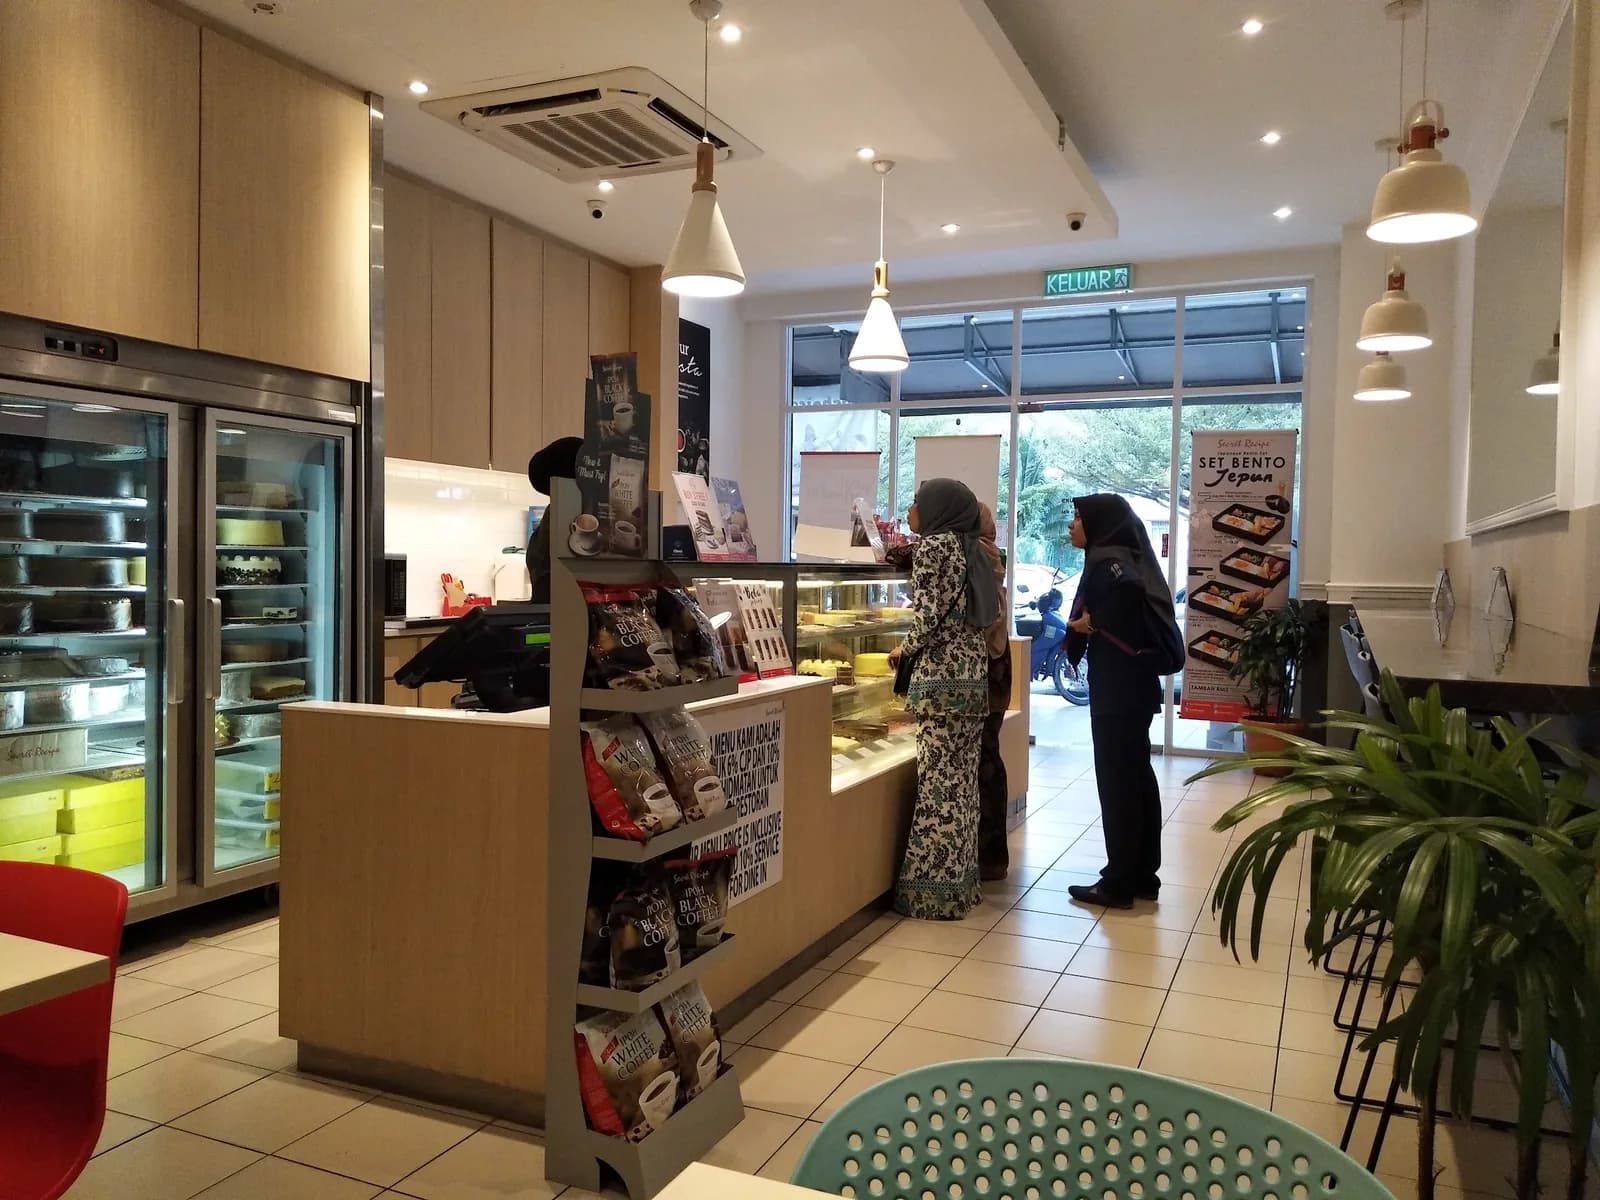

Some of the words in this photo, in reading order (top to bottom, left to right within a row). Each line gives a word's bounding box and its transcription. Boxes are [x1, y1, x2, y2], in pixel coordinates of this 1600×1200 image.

[1047, 270, 1111, 294] KELUAR
[1217, 439, 1241, 449] Secret
[1245, 439, 1271, 449] Recipe
[1199, 457, 1225, 468] SET
[1232, 456, 1286, 469] BENTO
[1204, 468, 1273, 488] Jepun
[714, 730, 736, 757] MENU
[737, 725, 755, 751] KAMI
[756, 719, 781, 747] ADALAH
[728, 753, 739, 776] 6%
[752, 744, 766, 768] DAN
[766, 741, 780, 764] 10%
[757, 762, 779, 788] UNTUK
[723, 827, 742, 850] PRICE
[742, 823, 749, 847] IS
[750, 810, 782, 845] INCLUSIVE
[740, 847, 754, 871] 10%
[754, 833, 780, 864] SERVICE
[684, 885, 705, 898] IPOH
[729, 873, 743, 900] FOR
[743, 865, 759, 892] DINE
[760, 860, 768, 884] IN
[676, 906, 719, 926] COFFEE
[679, 893, 719, 913] BLACK
[612, 1031, 651, 1065] WHITE
[616, 1043, 657, 1080] COFFEE
